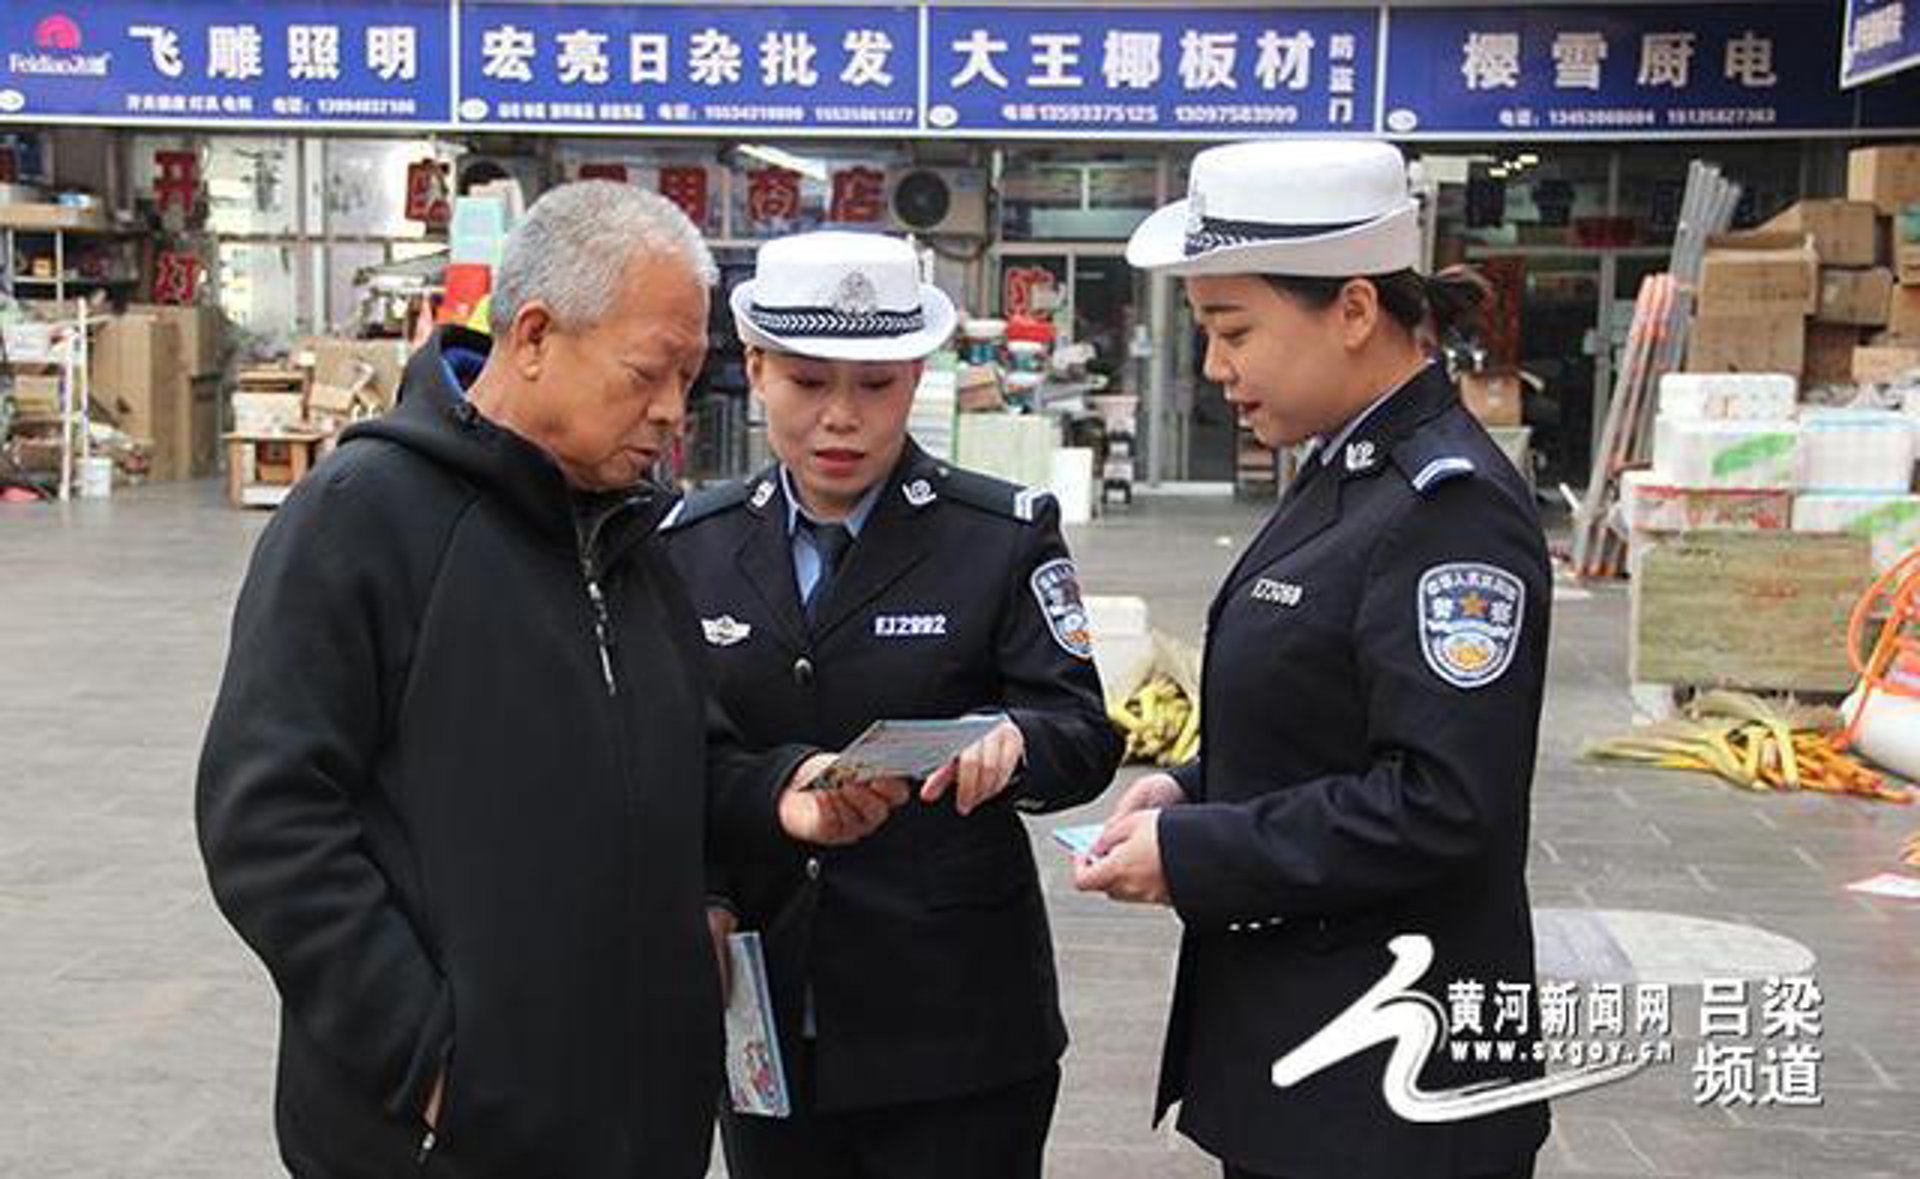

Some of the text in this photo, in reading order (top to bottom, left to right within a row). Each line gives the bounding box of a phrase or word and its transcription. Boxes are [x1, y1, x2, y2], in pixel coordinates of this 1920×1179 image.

[129, 25, 417, 80] 飞雕照明
[481, 25, 894, 86] 宏亮日杂批发
[950, 29, 1316, 90] 大王椰板材
[1460, 32, 1777, 91] 樱雪厨电
